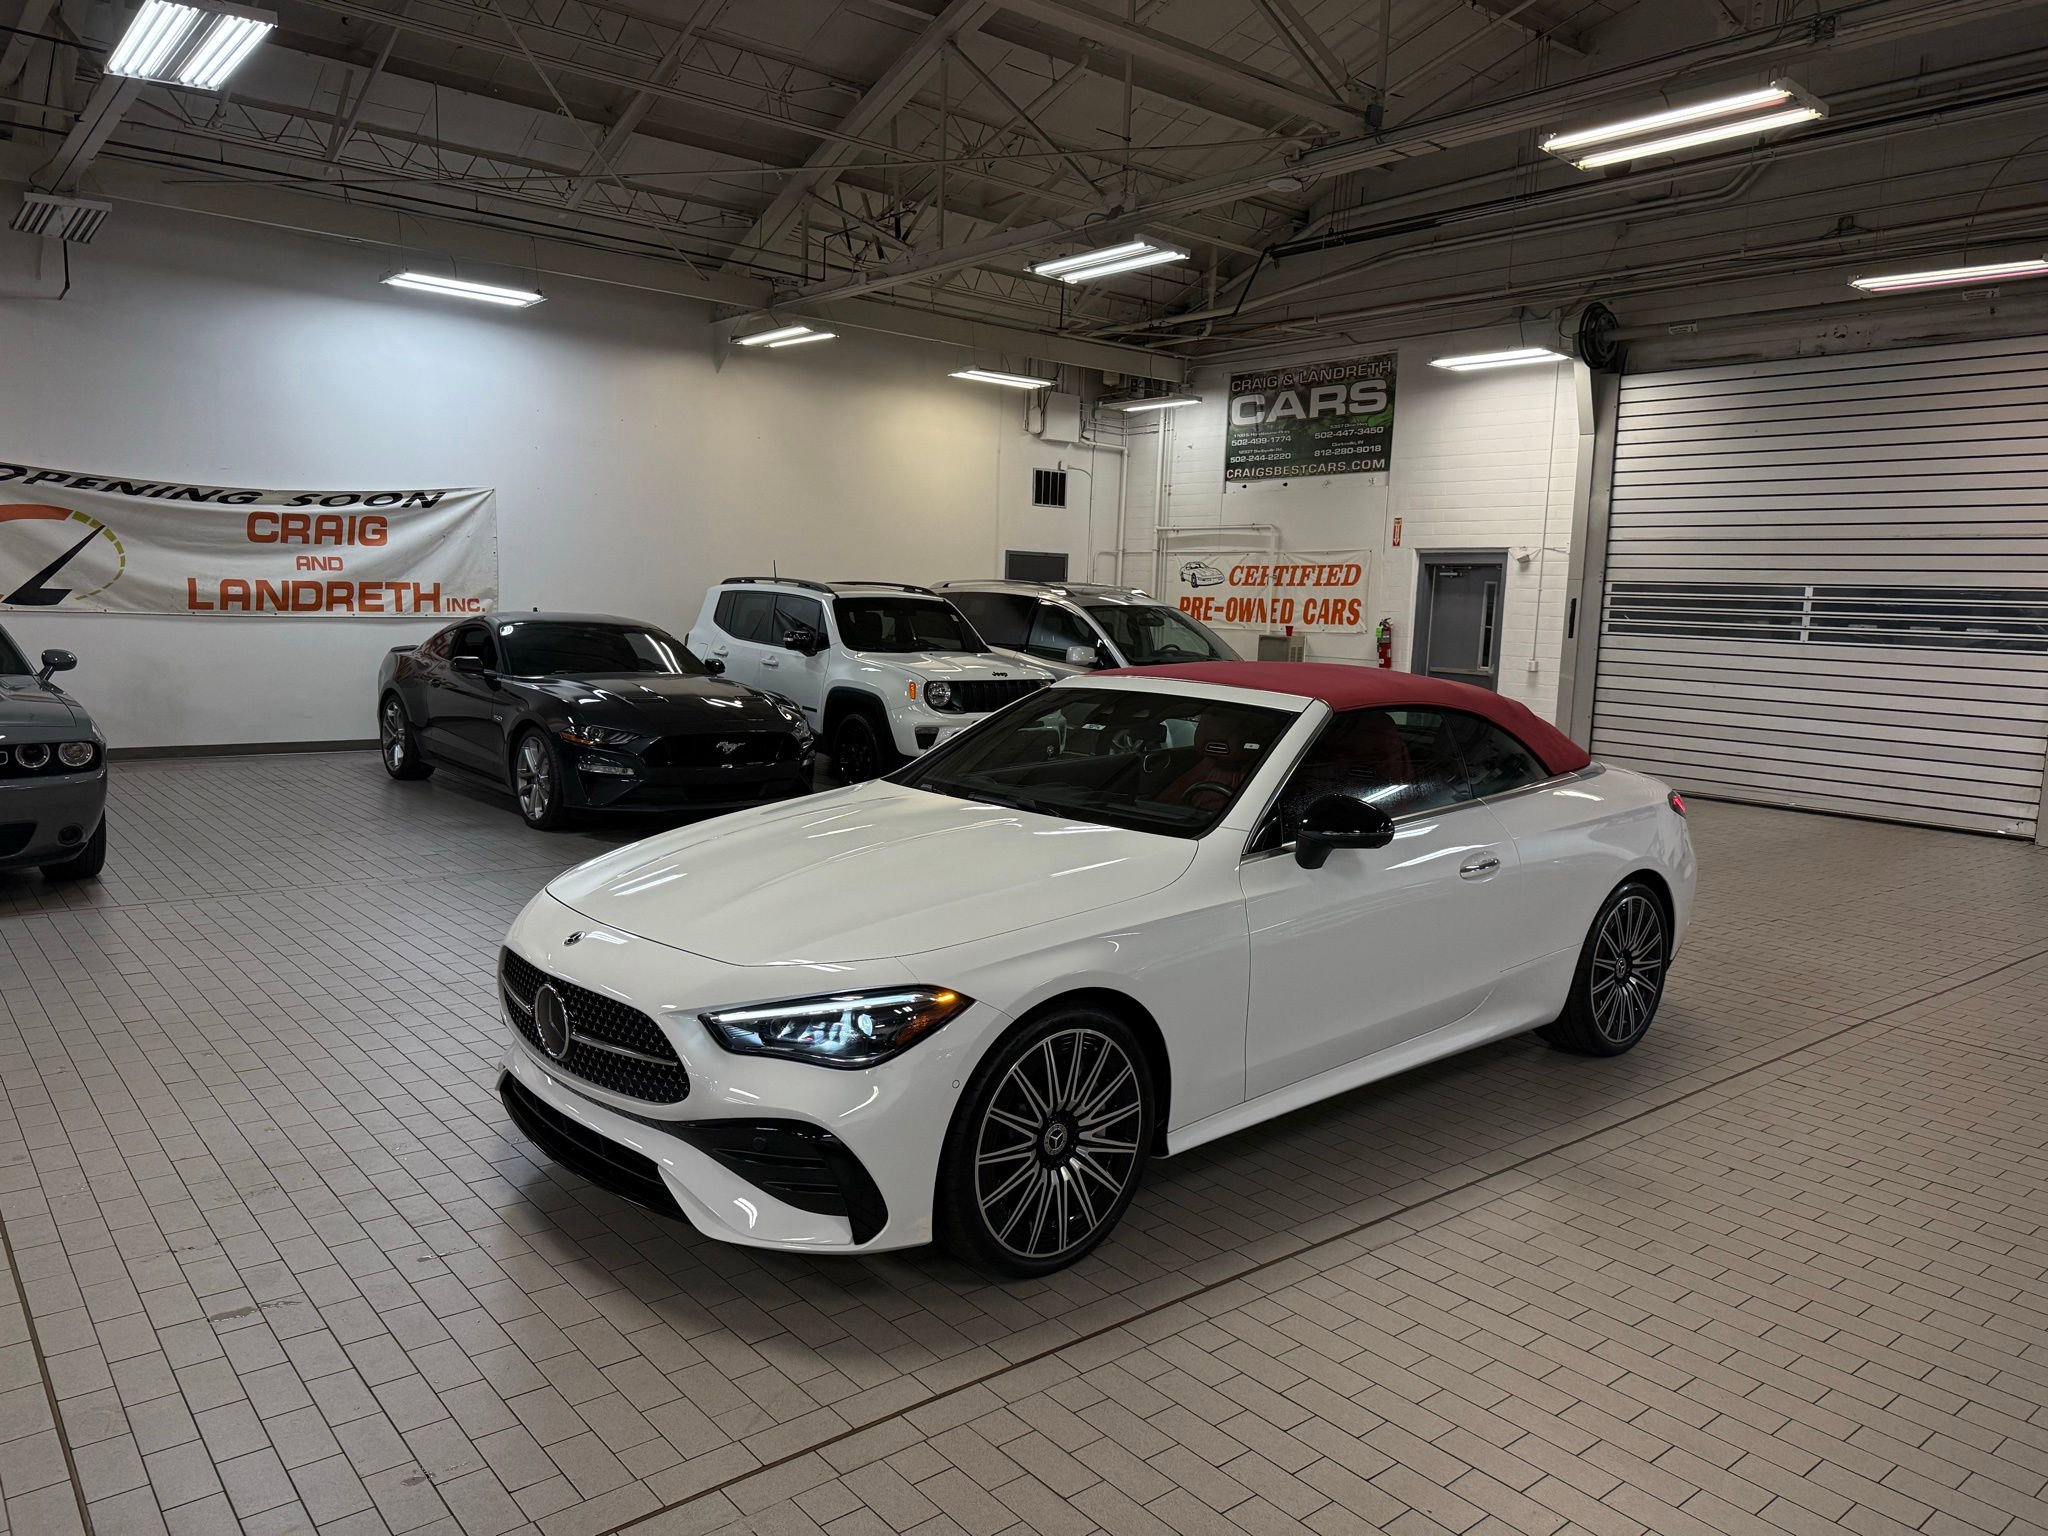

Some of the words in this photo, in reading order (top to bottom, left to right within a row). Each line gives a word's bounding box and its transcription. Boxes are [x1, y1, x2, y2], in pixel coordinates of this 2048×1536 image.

[1231, 375, 1278, 393] CRAIG
[1283, 374, 1294, 386] &
[1300, 360, 1392, 384] LANDRETH
[1231, 379, 1388, 427] CARS
[1231, 435, 1292, 447] 502-499-1774
[1314, 426, 1384, 440] 502-447-3450
[1230, 452, 1292, 464] 502-244-2220
[1314, 445, 1382, 457] 812-280-8018
[1226, 458, 1386, 479] CRAIGSBESTCARS.COM
[283, 491, 446, 509] SOON
[246, 511, 389, 547] CRAIG
[295, 555, 344, 572] AND
[187, 577, 441, 613] LANDRETH
[446, 597, 487, 613] INC.
[1302, 598, 1362, 626] CARS
